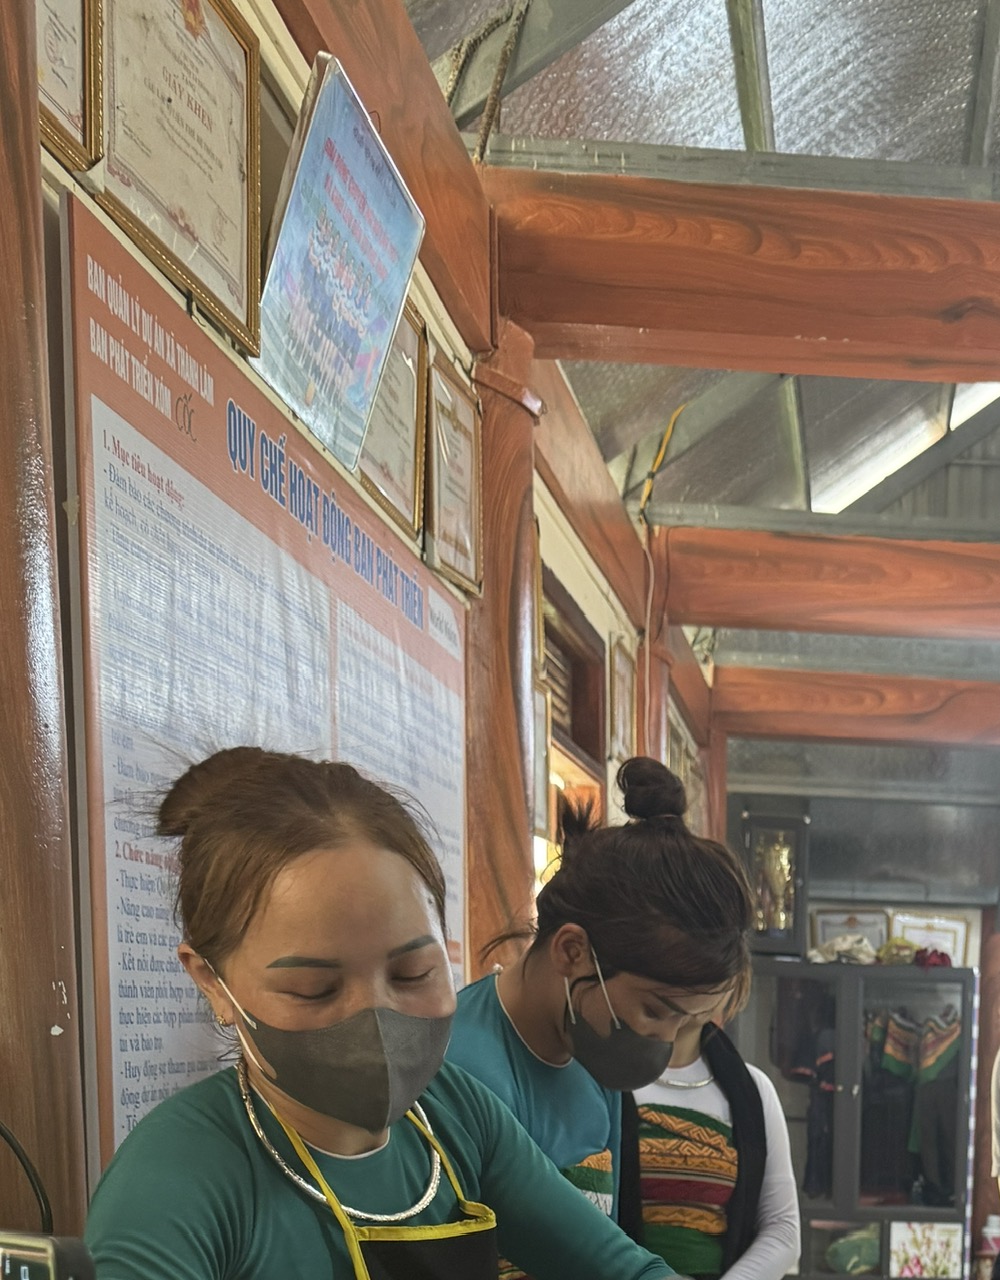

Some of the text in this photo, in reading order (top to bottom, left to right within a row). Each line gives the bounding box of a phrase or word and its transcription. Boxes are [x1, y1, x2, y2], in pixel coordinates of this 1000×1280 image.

[162, 66, 185, 99] GIẤY
[186, 92, 213, 133] KHEN
[87, 254, 106, 304] BAN
[107, 274, 130, 328] QUẢN
[89, 317, 108, 365] BAN
[109, 338, 130, 385] PHÁT
[131, 355, 154, 406] TRIỂN
[112, 435, 130, 468] Mục
[227, 397, 256, 481] QUY
[260, 430, 286, 508] CHẾ
[288, 456, 320, 543] HOẠT
[321, 487, 352, 566] ĐỘNG
[353, 522, 374, 586] BAN
[376, 546, 398, 609] PHÁT
[124, 1061, 141, 1082] Huy
